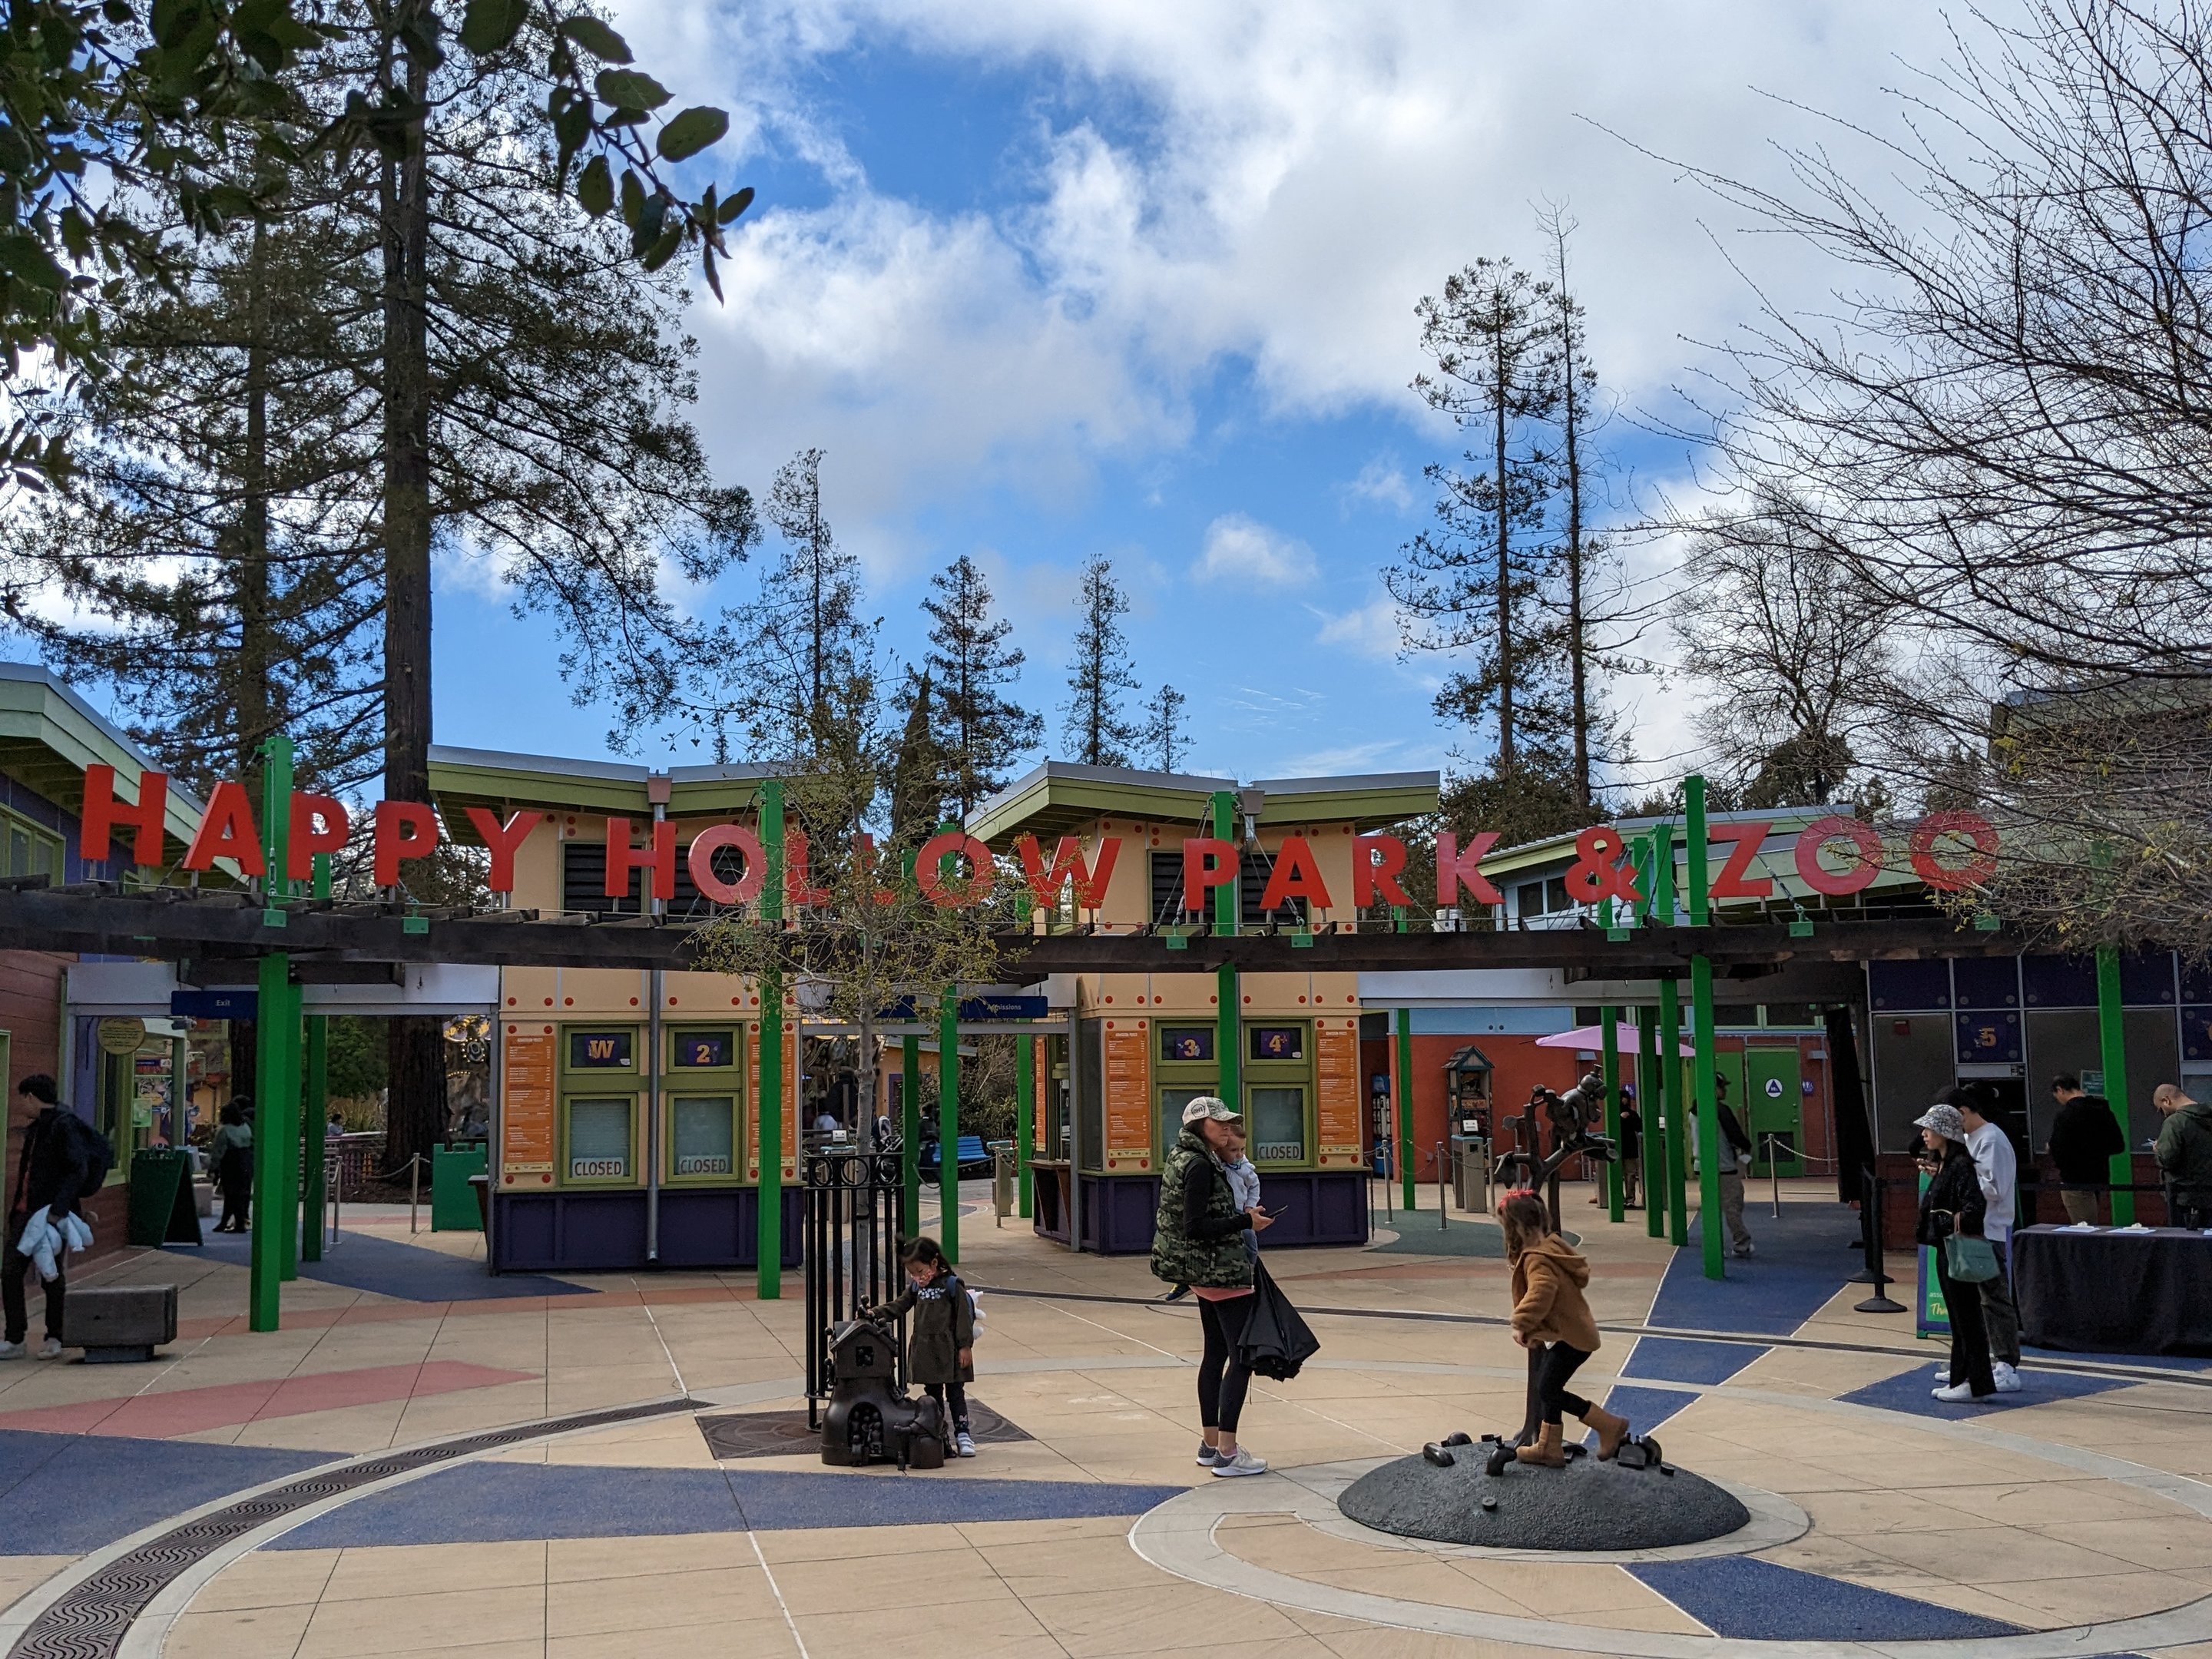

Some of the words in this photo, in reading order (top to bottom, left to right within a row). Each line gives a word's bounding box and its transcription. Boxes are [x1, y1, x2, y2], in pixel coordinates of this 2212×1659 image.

[80, 763, 543, 892] HAPPY
[1183, 832, 1505, 910] PARK
[1565, 826, 1644, 902] &
[1708, 810, 2000, 897] ZOO
[1269, 1035, 1282, 1052] 4
[1979, 1027, 1997, 1047] 5
[589, 1039, 615, 1060] W
[696, 1044, 711, 1063] 2
[1184, 1038, 1197, 1058] 3
[1258, 1145, 1300, 1160] CLOSED
[574, 1161, 622, 1176] CLOSED
[680, 1158, 727, 1174] CLOSED
